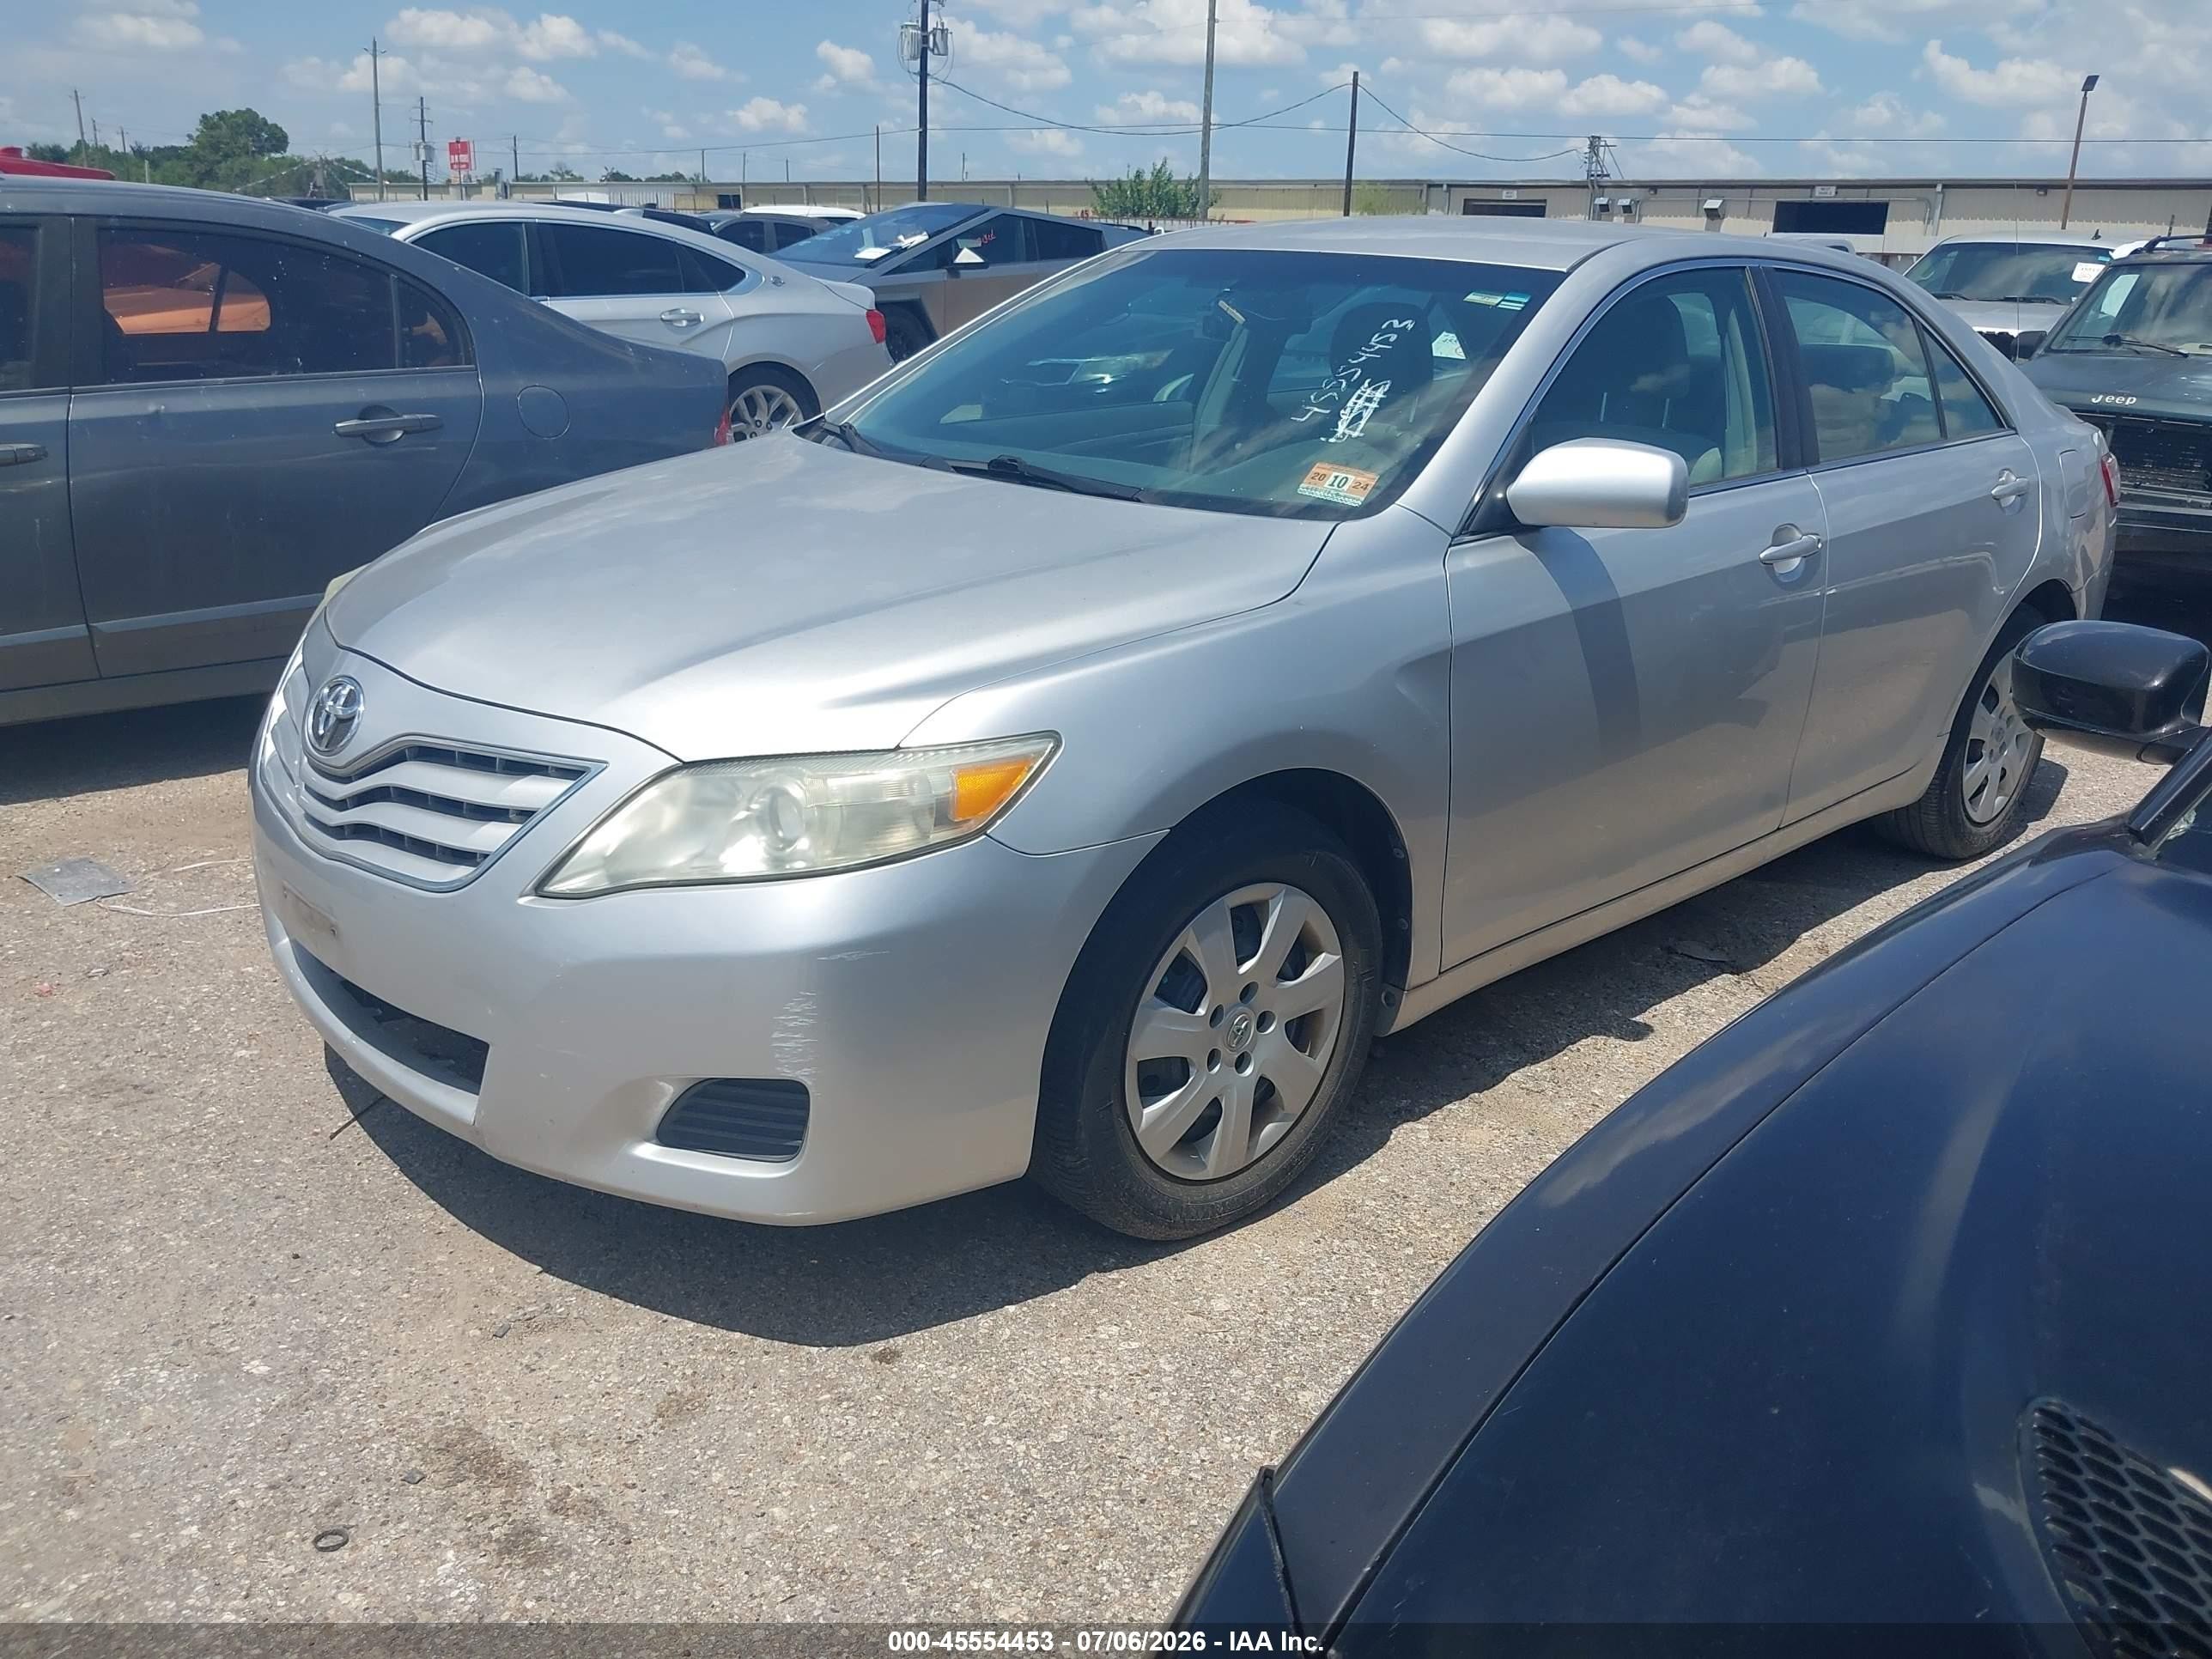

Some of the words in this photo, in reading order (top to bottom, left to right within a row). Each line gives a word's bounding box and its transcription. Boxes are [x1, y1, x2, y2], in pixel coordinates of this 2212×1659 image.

[1290, 319, 1416, 422] 45554453
[2091, 394, 2137, 405] Jeep
[1310, 471, 1327, 482] 20
[1328, 474, 1349, 489] 10
[1352, 481, 1370, 491] 24
